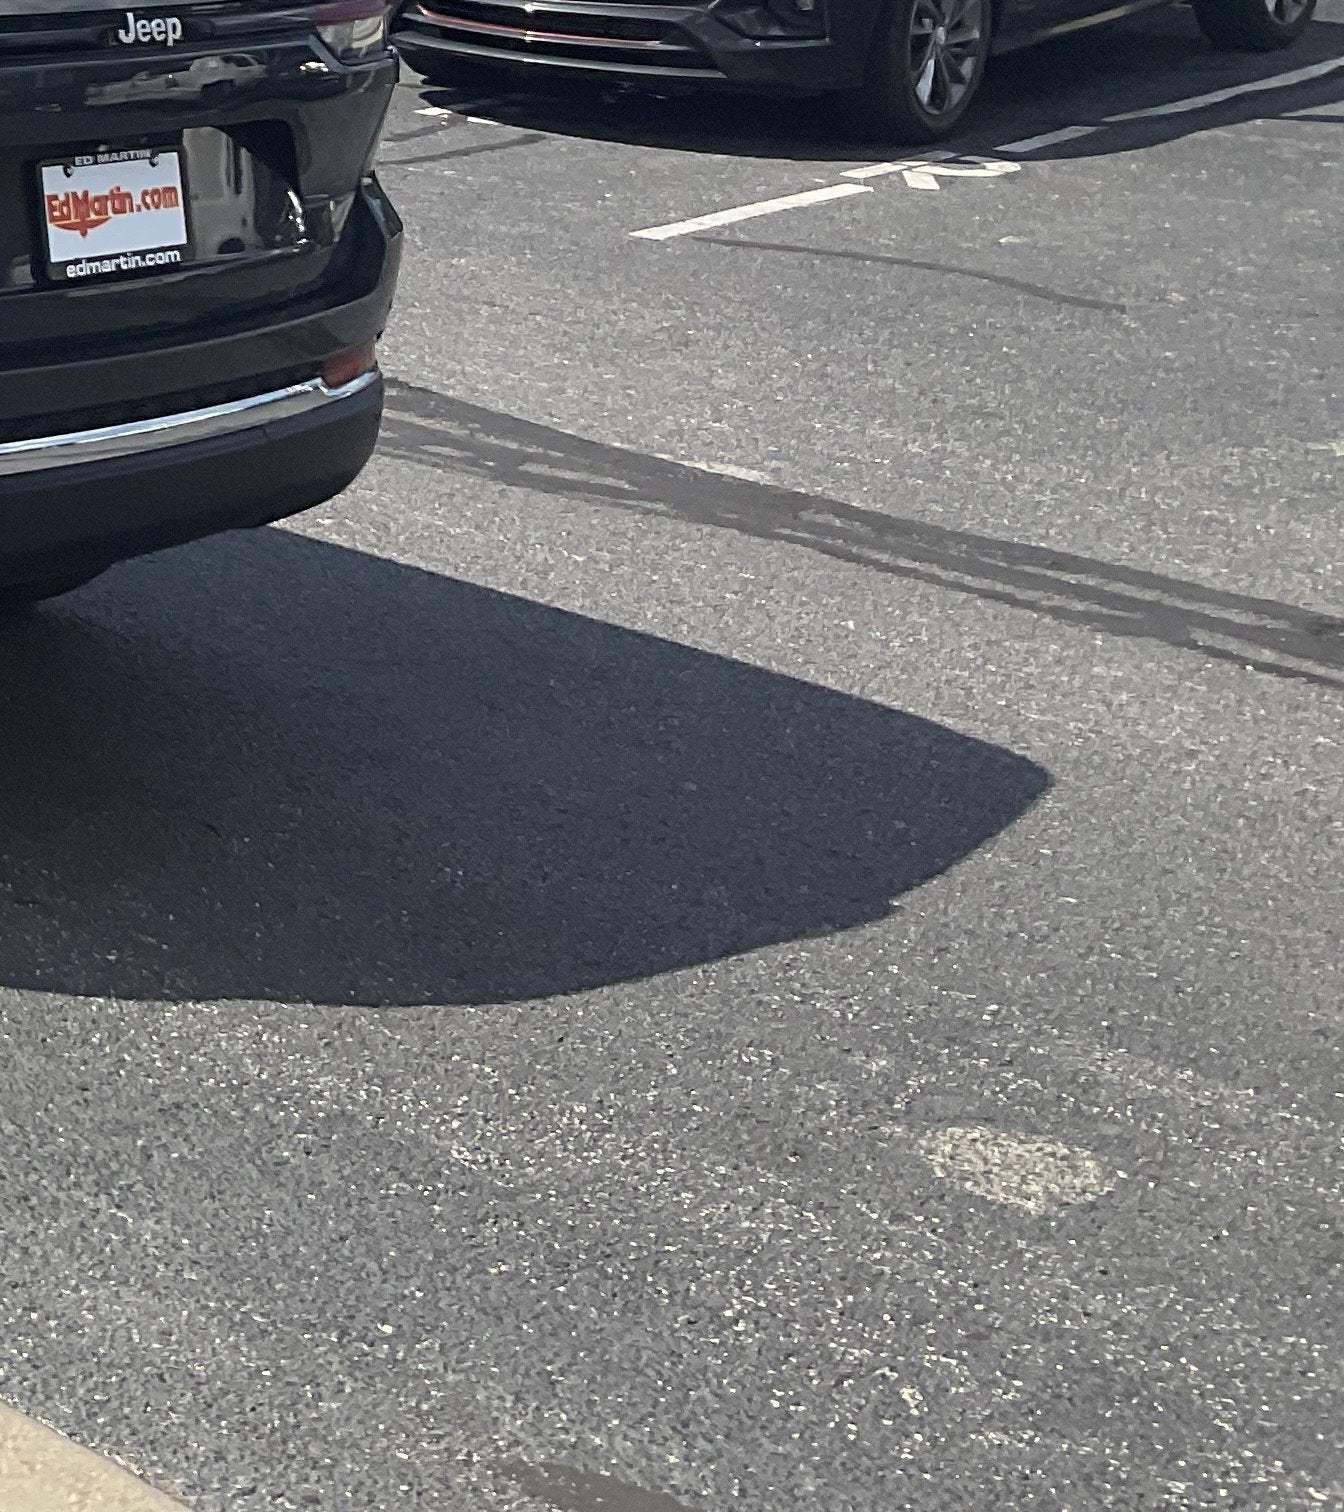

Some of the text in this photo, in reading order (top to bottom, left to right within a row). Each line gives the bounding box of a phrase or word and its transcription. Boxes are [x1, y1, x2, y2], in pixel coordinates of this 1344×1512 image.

[118, 12, 183, 46] Jeep
[74, 148, 153, 166] ED MARTIN
[46, 186, 179, 237] EdMartin.com
[66, 247, 182, 279] edmartin.com
